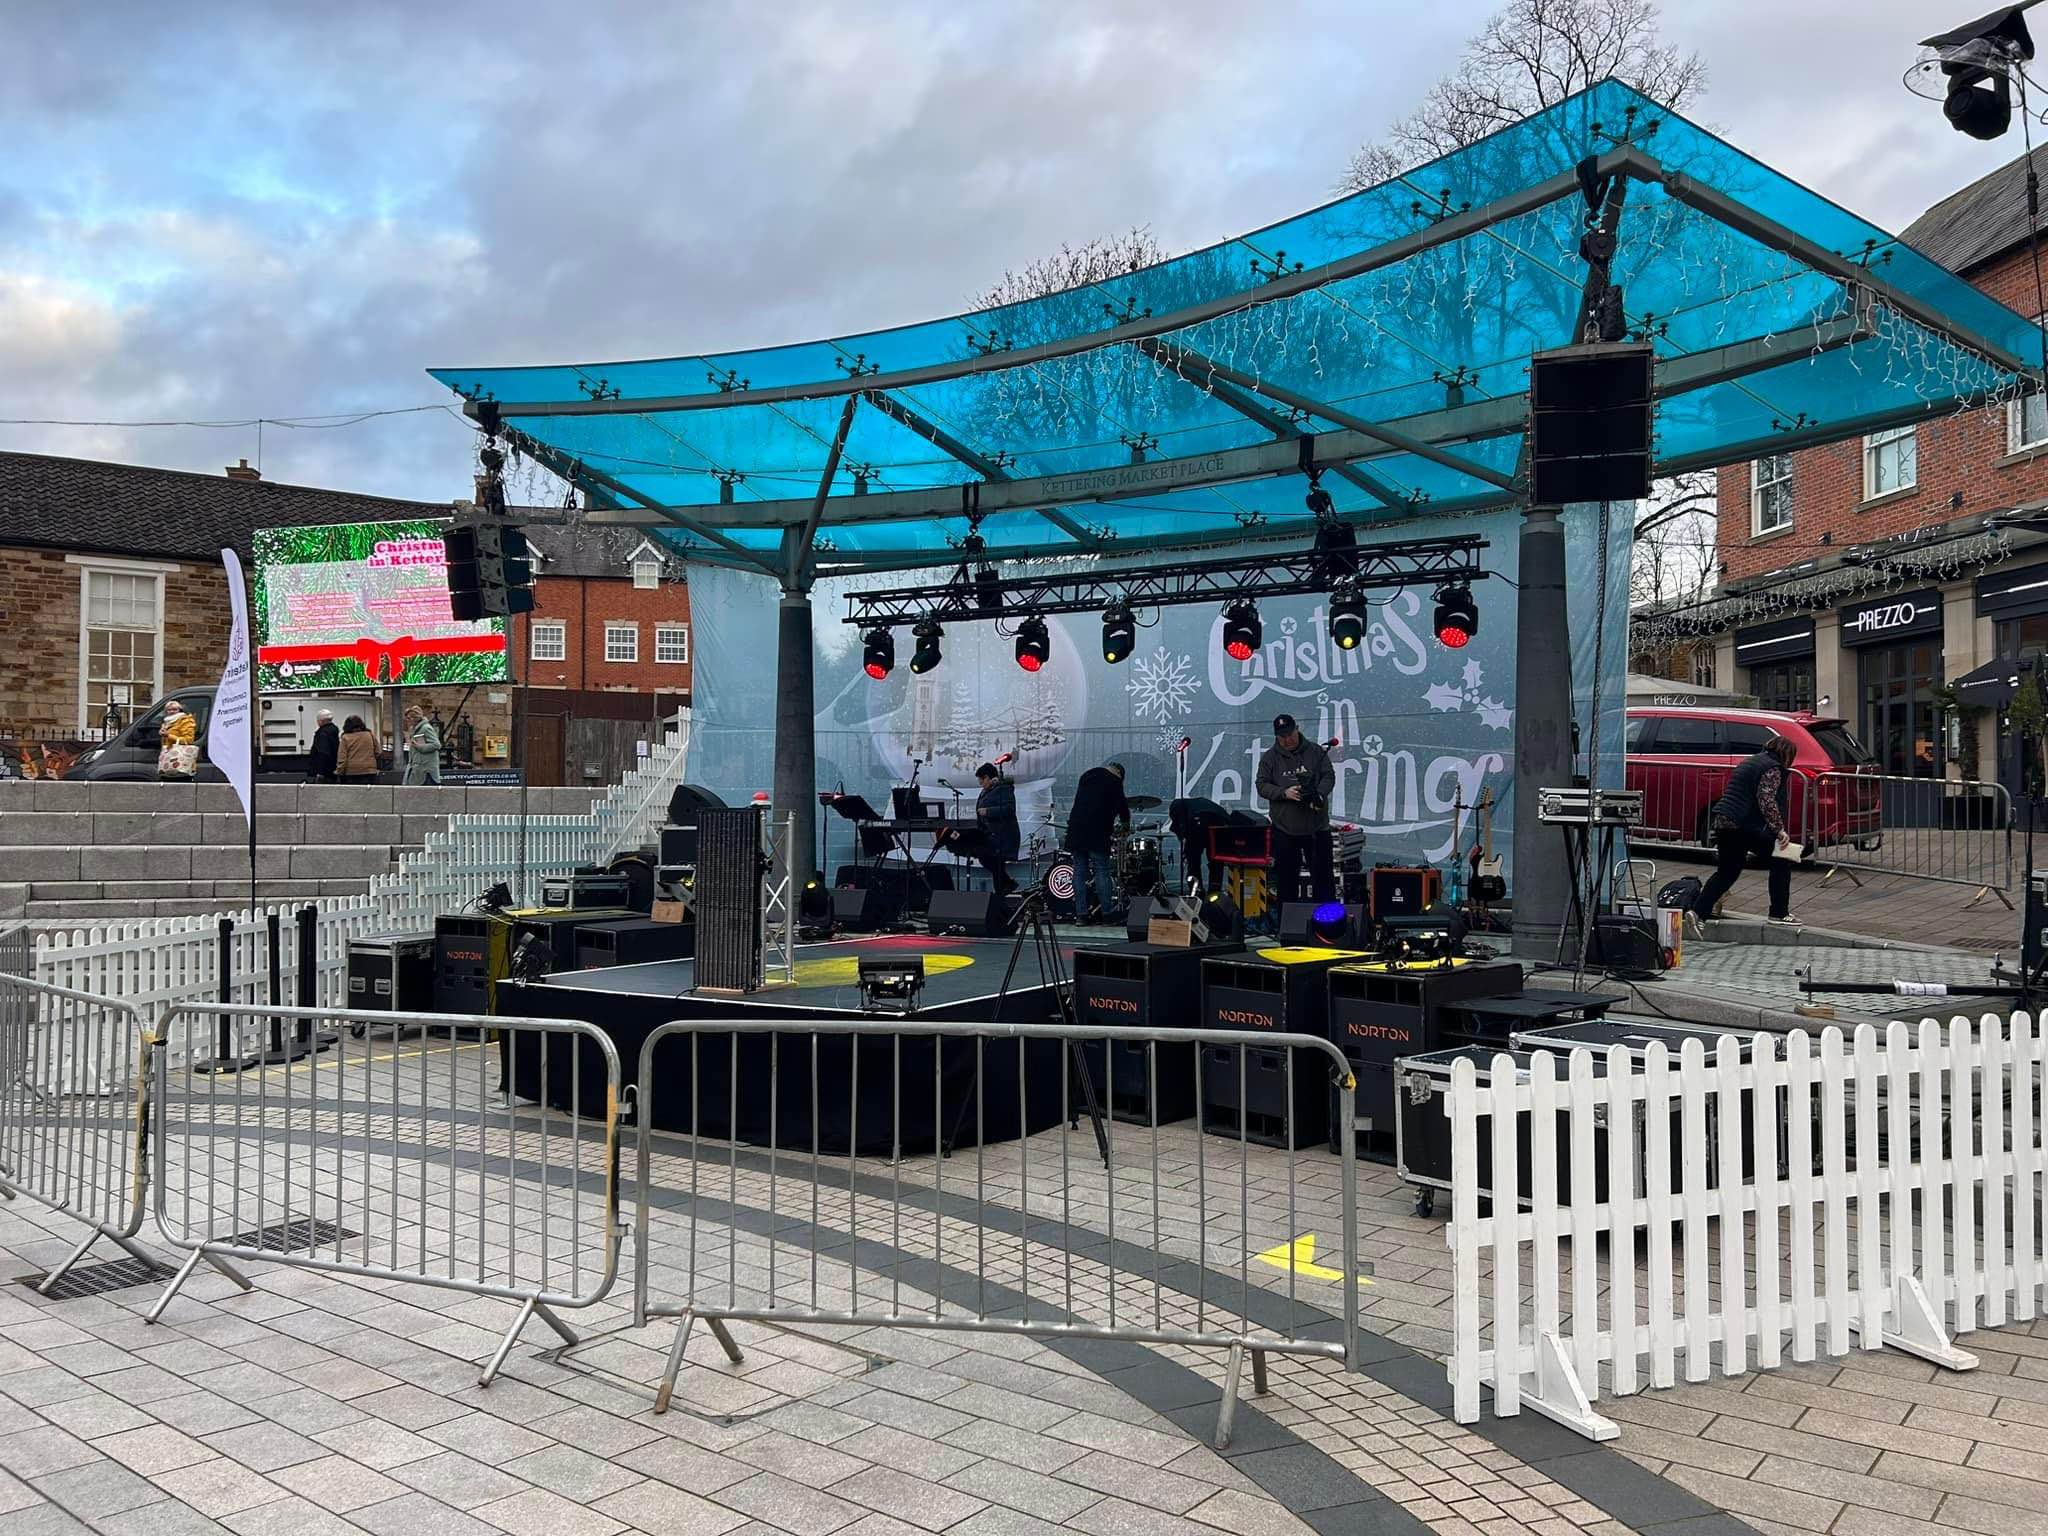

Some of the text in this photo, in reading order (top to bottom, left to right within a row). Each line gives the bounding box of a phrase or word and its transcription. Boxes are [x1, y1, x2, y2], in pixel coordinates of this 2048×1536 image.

[1041, 458, 1225, 495] KETTERING MARKET PLACE
[376, 541, 443, 553] Christm
[369, 554, 443, 567] in Ketter
[429, 566, 447, 576] 20
[1858, 602, 1915, 633] PREZZO
[1653, 694, 1697, 706] PREZZO
[1315, 692, 1361, 747] in
[1162, 732, 1504, 864] Ketring
[446, 951, 482, 961] NORTON
[1089, 997, 1137, 1012] NORTON
[1218, 1009, 1273, 1027] NORTON
[1348, 1023, 1409, 1042] NORTON
